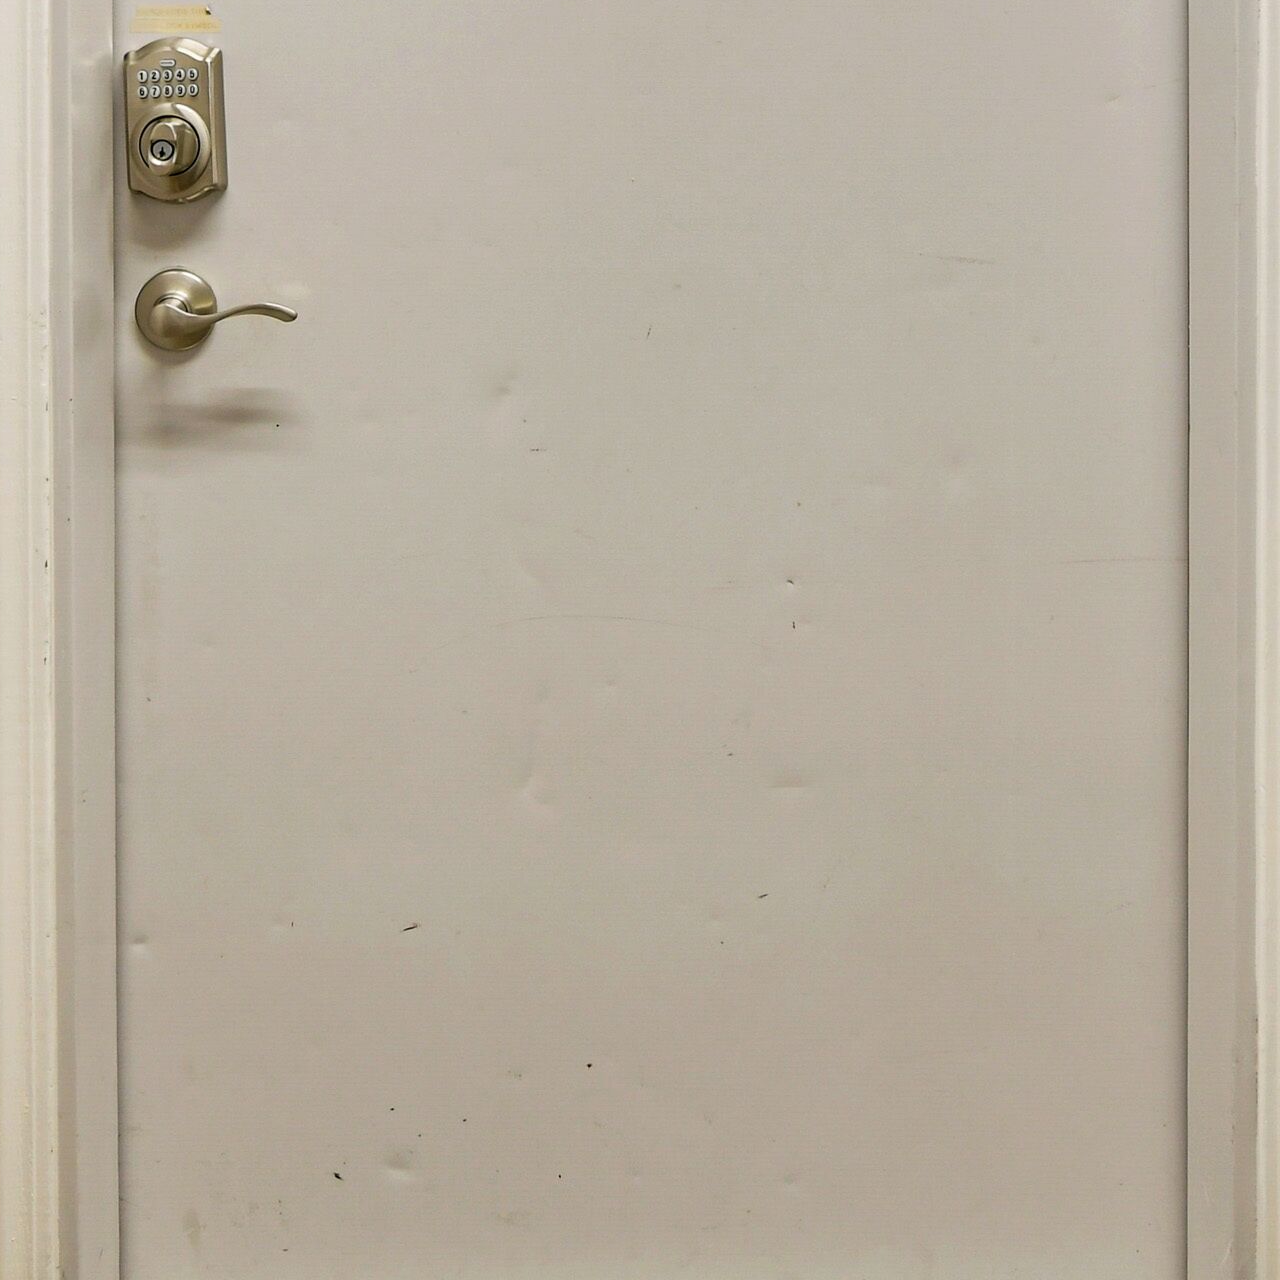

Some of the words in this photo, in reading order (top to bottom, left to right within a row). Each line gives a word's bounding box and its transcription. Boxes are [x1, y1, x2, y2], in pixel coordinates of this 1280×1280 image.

[151, 71, 157, 80] 2
[164, 71, 170, 80] 3
[176, 70, 182, 79] 4
[189, 70, 195, 78] 5
[139, 87, 145, 96] 6
[177, 86, 183, 95] 9
[190, 85, 195, 94] 0
